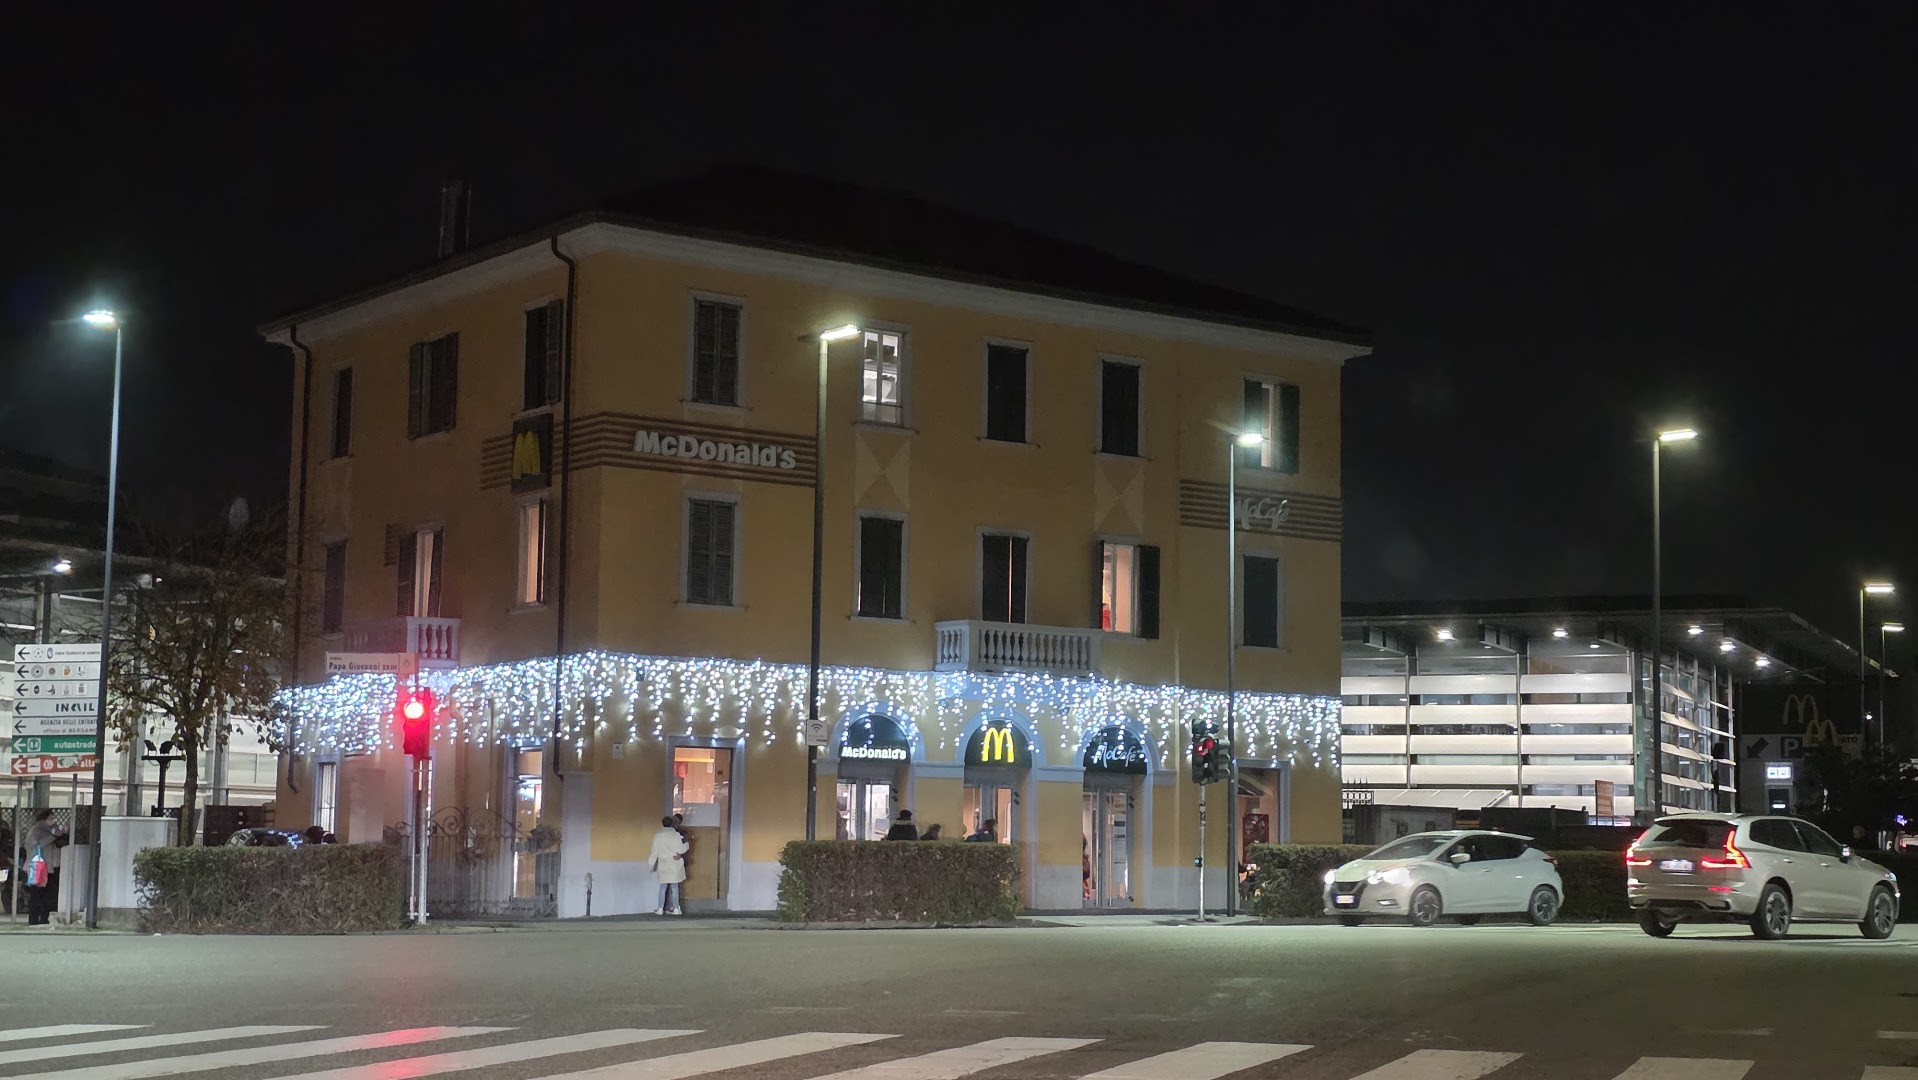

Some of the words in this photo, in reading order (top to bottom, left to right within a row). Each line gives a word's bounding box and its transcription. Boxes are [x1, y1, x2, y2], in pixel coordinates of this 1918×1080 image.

[633, 430, 796, 469] McDonald's
[329, 662, 346, 671] Papa
[349, 662, 380, 670] Giovanni
[56, 703, 95, 712] INAIL
[54, 741, 96, 749] autostrada
[841, 746, 907, 760] McDonald's
